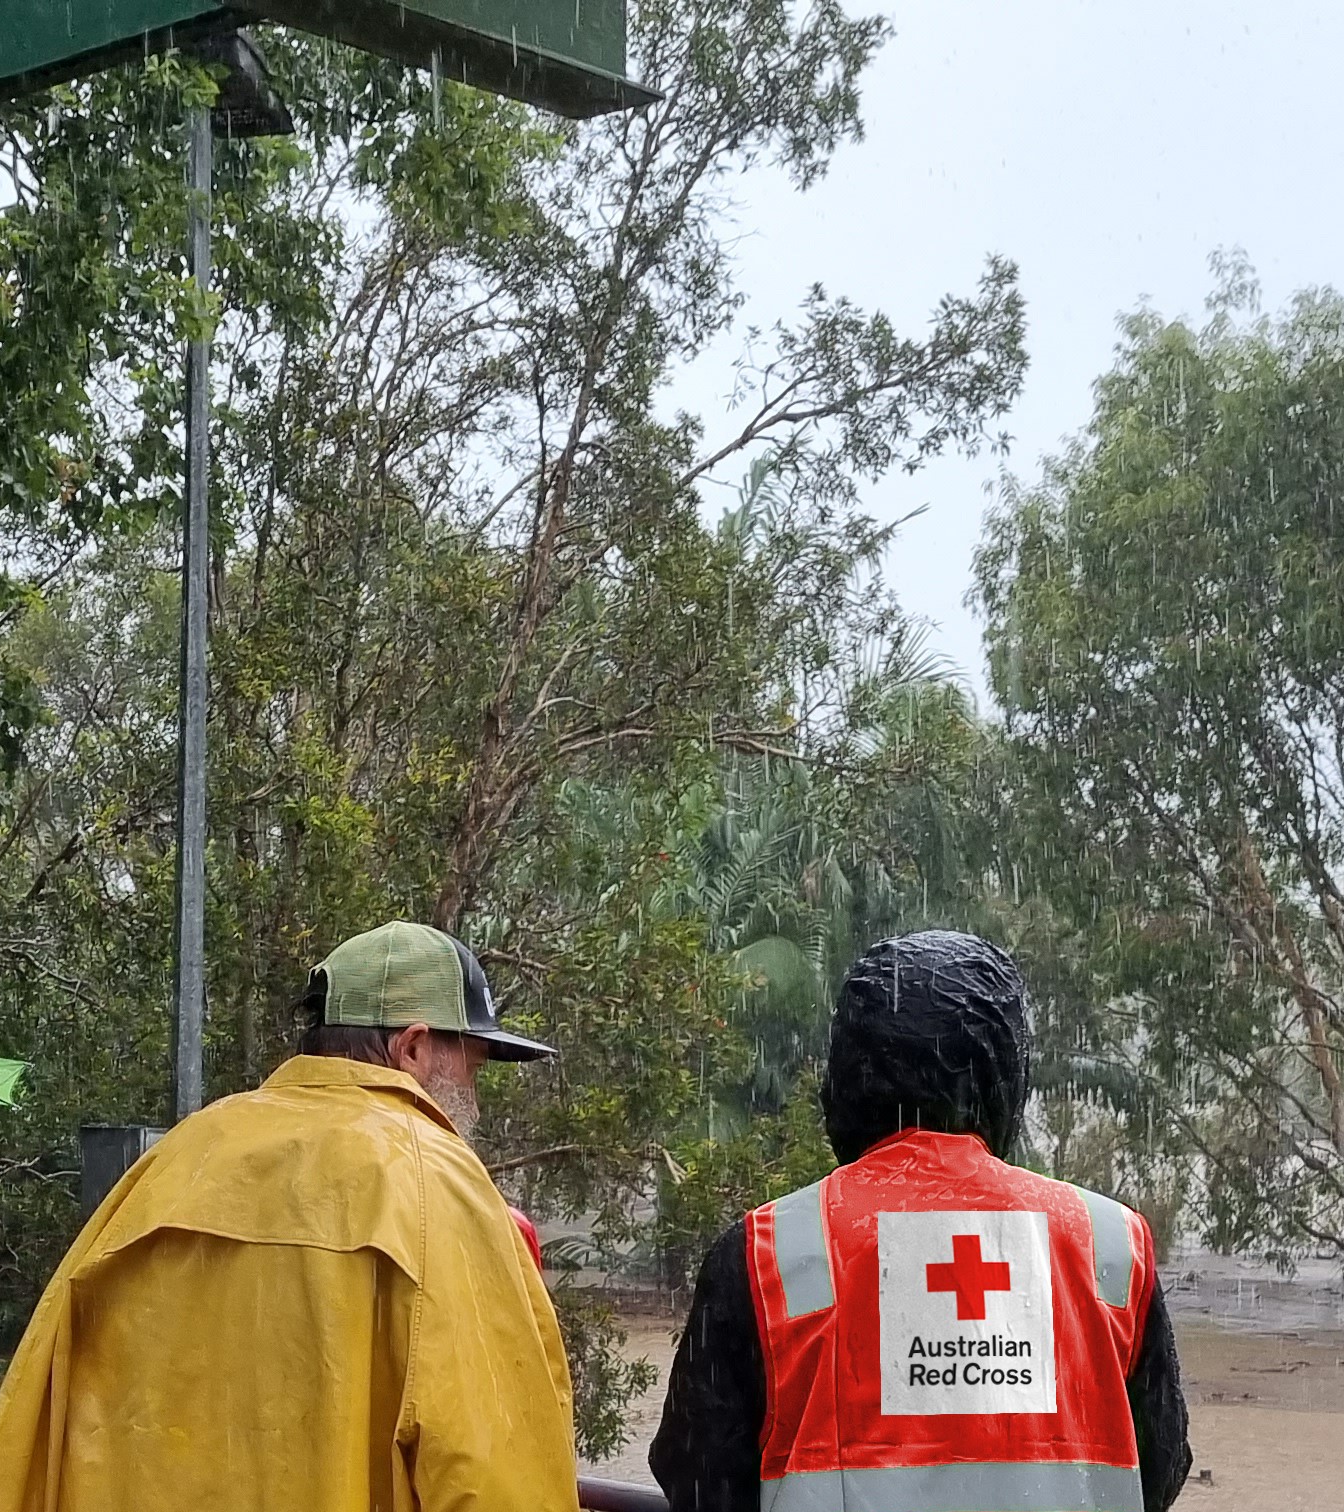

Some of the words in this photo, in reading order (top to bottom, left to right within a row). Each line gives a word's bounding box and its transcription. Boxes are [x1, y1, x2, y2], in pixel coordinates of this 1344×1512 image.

[908, 1335, 1032, 1358] Australian
[909, 1363, 957, 1386] Red
[962, 1362, 1032, 1385] Cross
